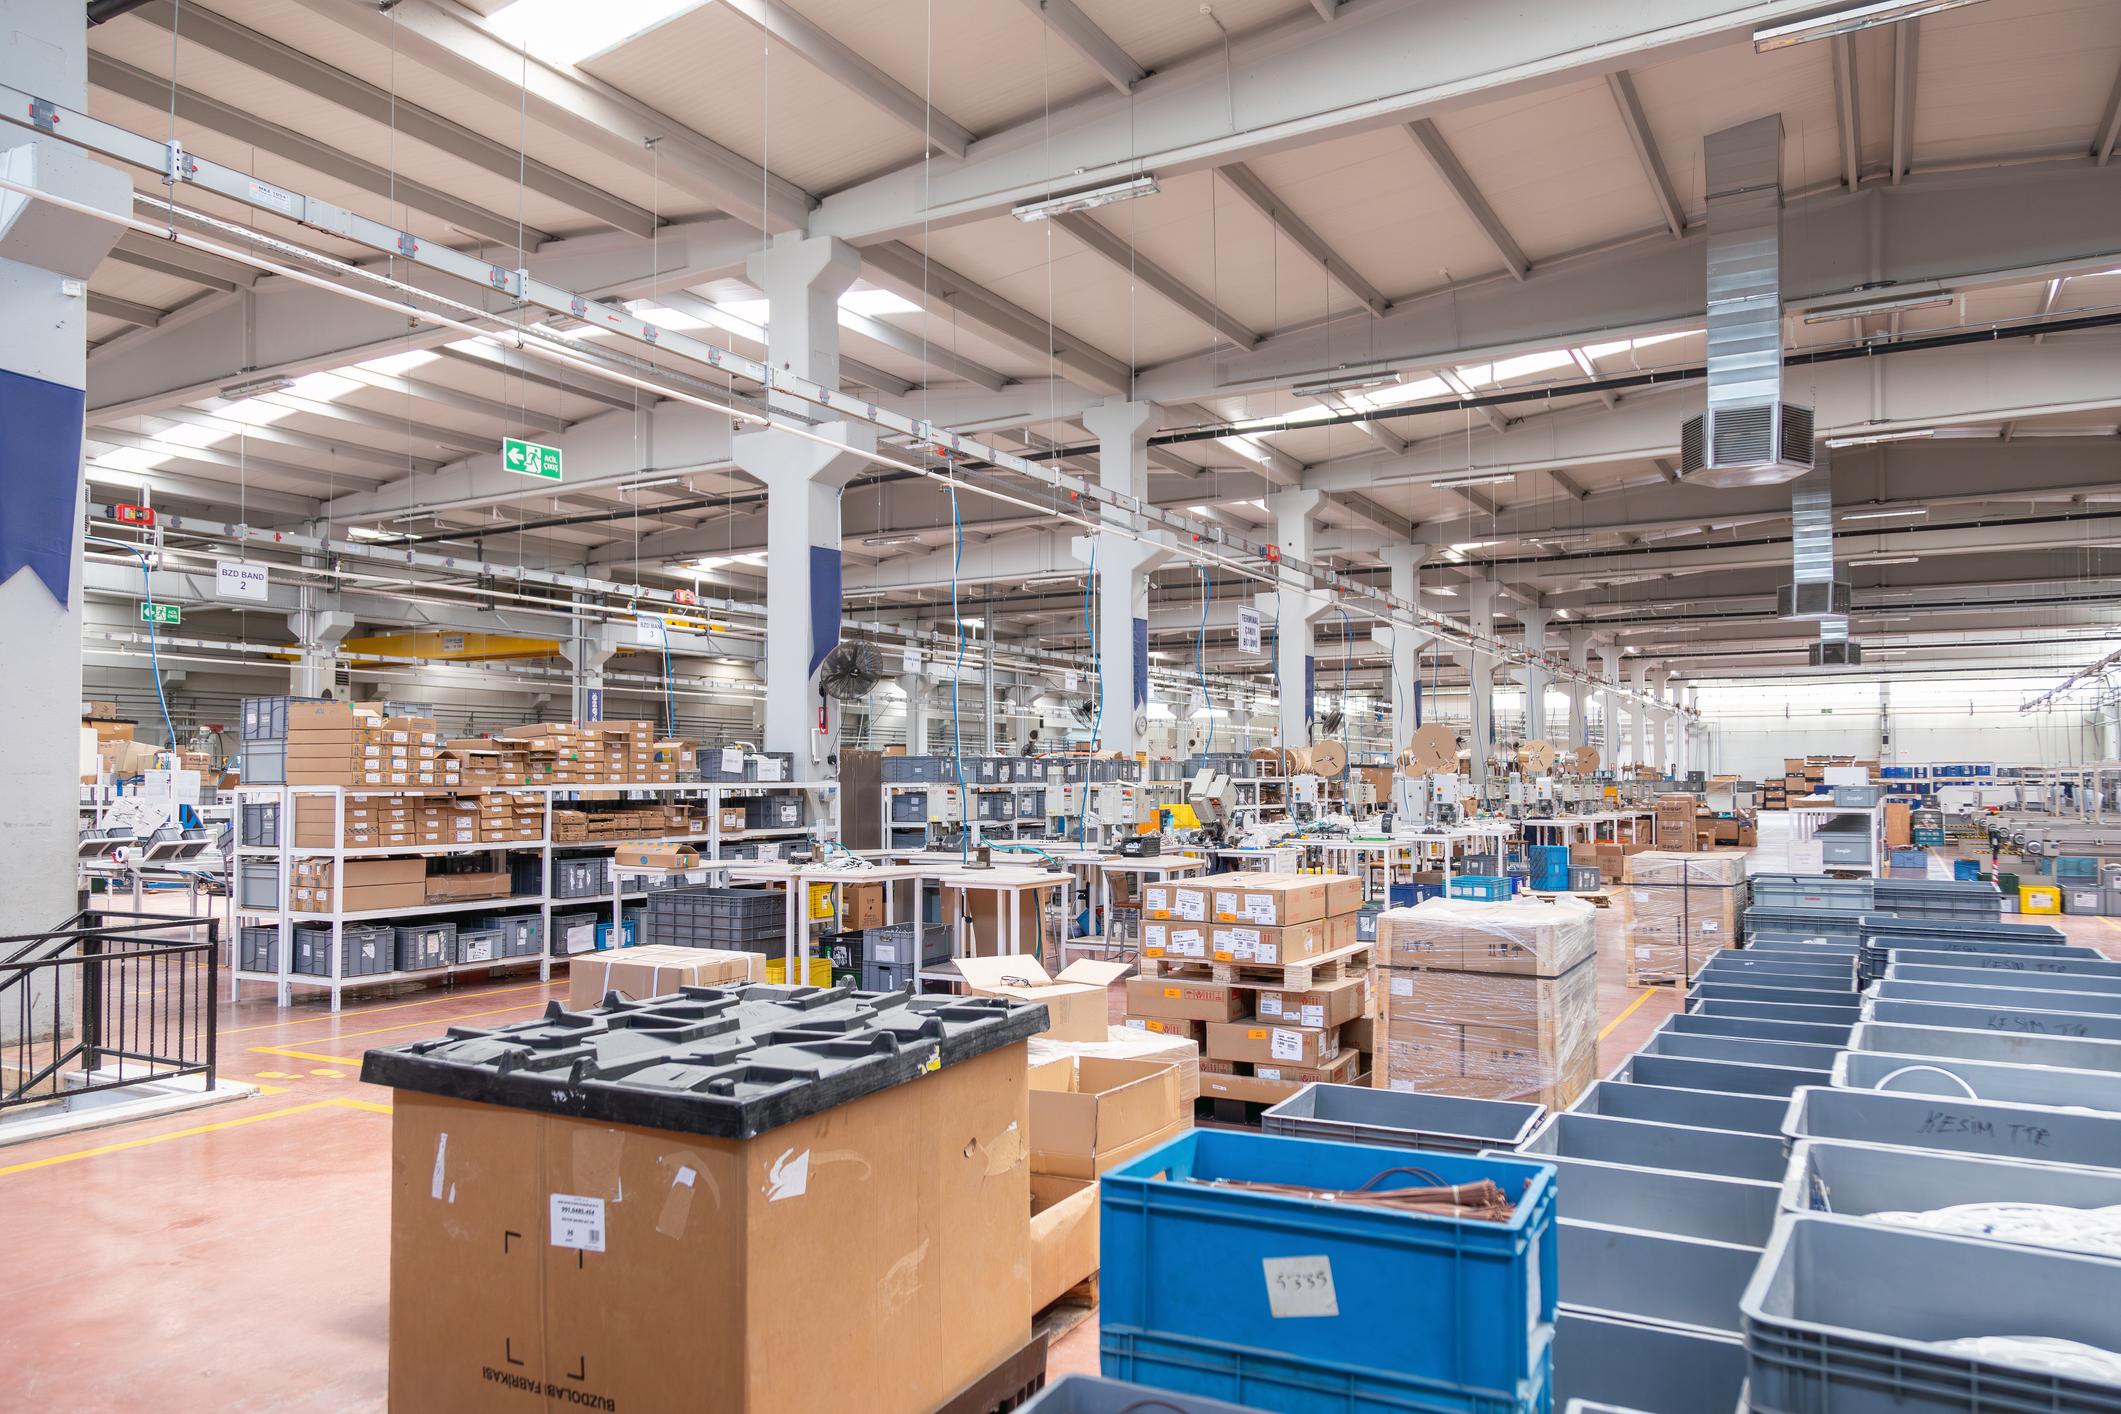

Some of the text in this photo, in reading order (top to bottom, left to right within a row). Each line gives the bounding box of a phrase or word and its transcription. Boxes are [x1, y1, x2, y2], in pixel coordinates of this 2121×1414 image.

[222, 569, 265, 581] BZD BAND
[240, 581, 246, 590] 2
[544, 1383, 616, 1412] BUZDOLABI
